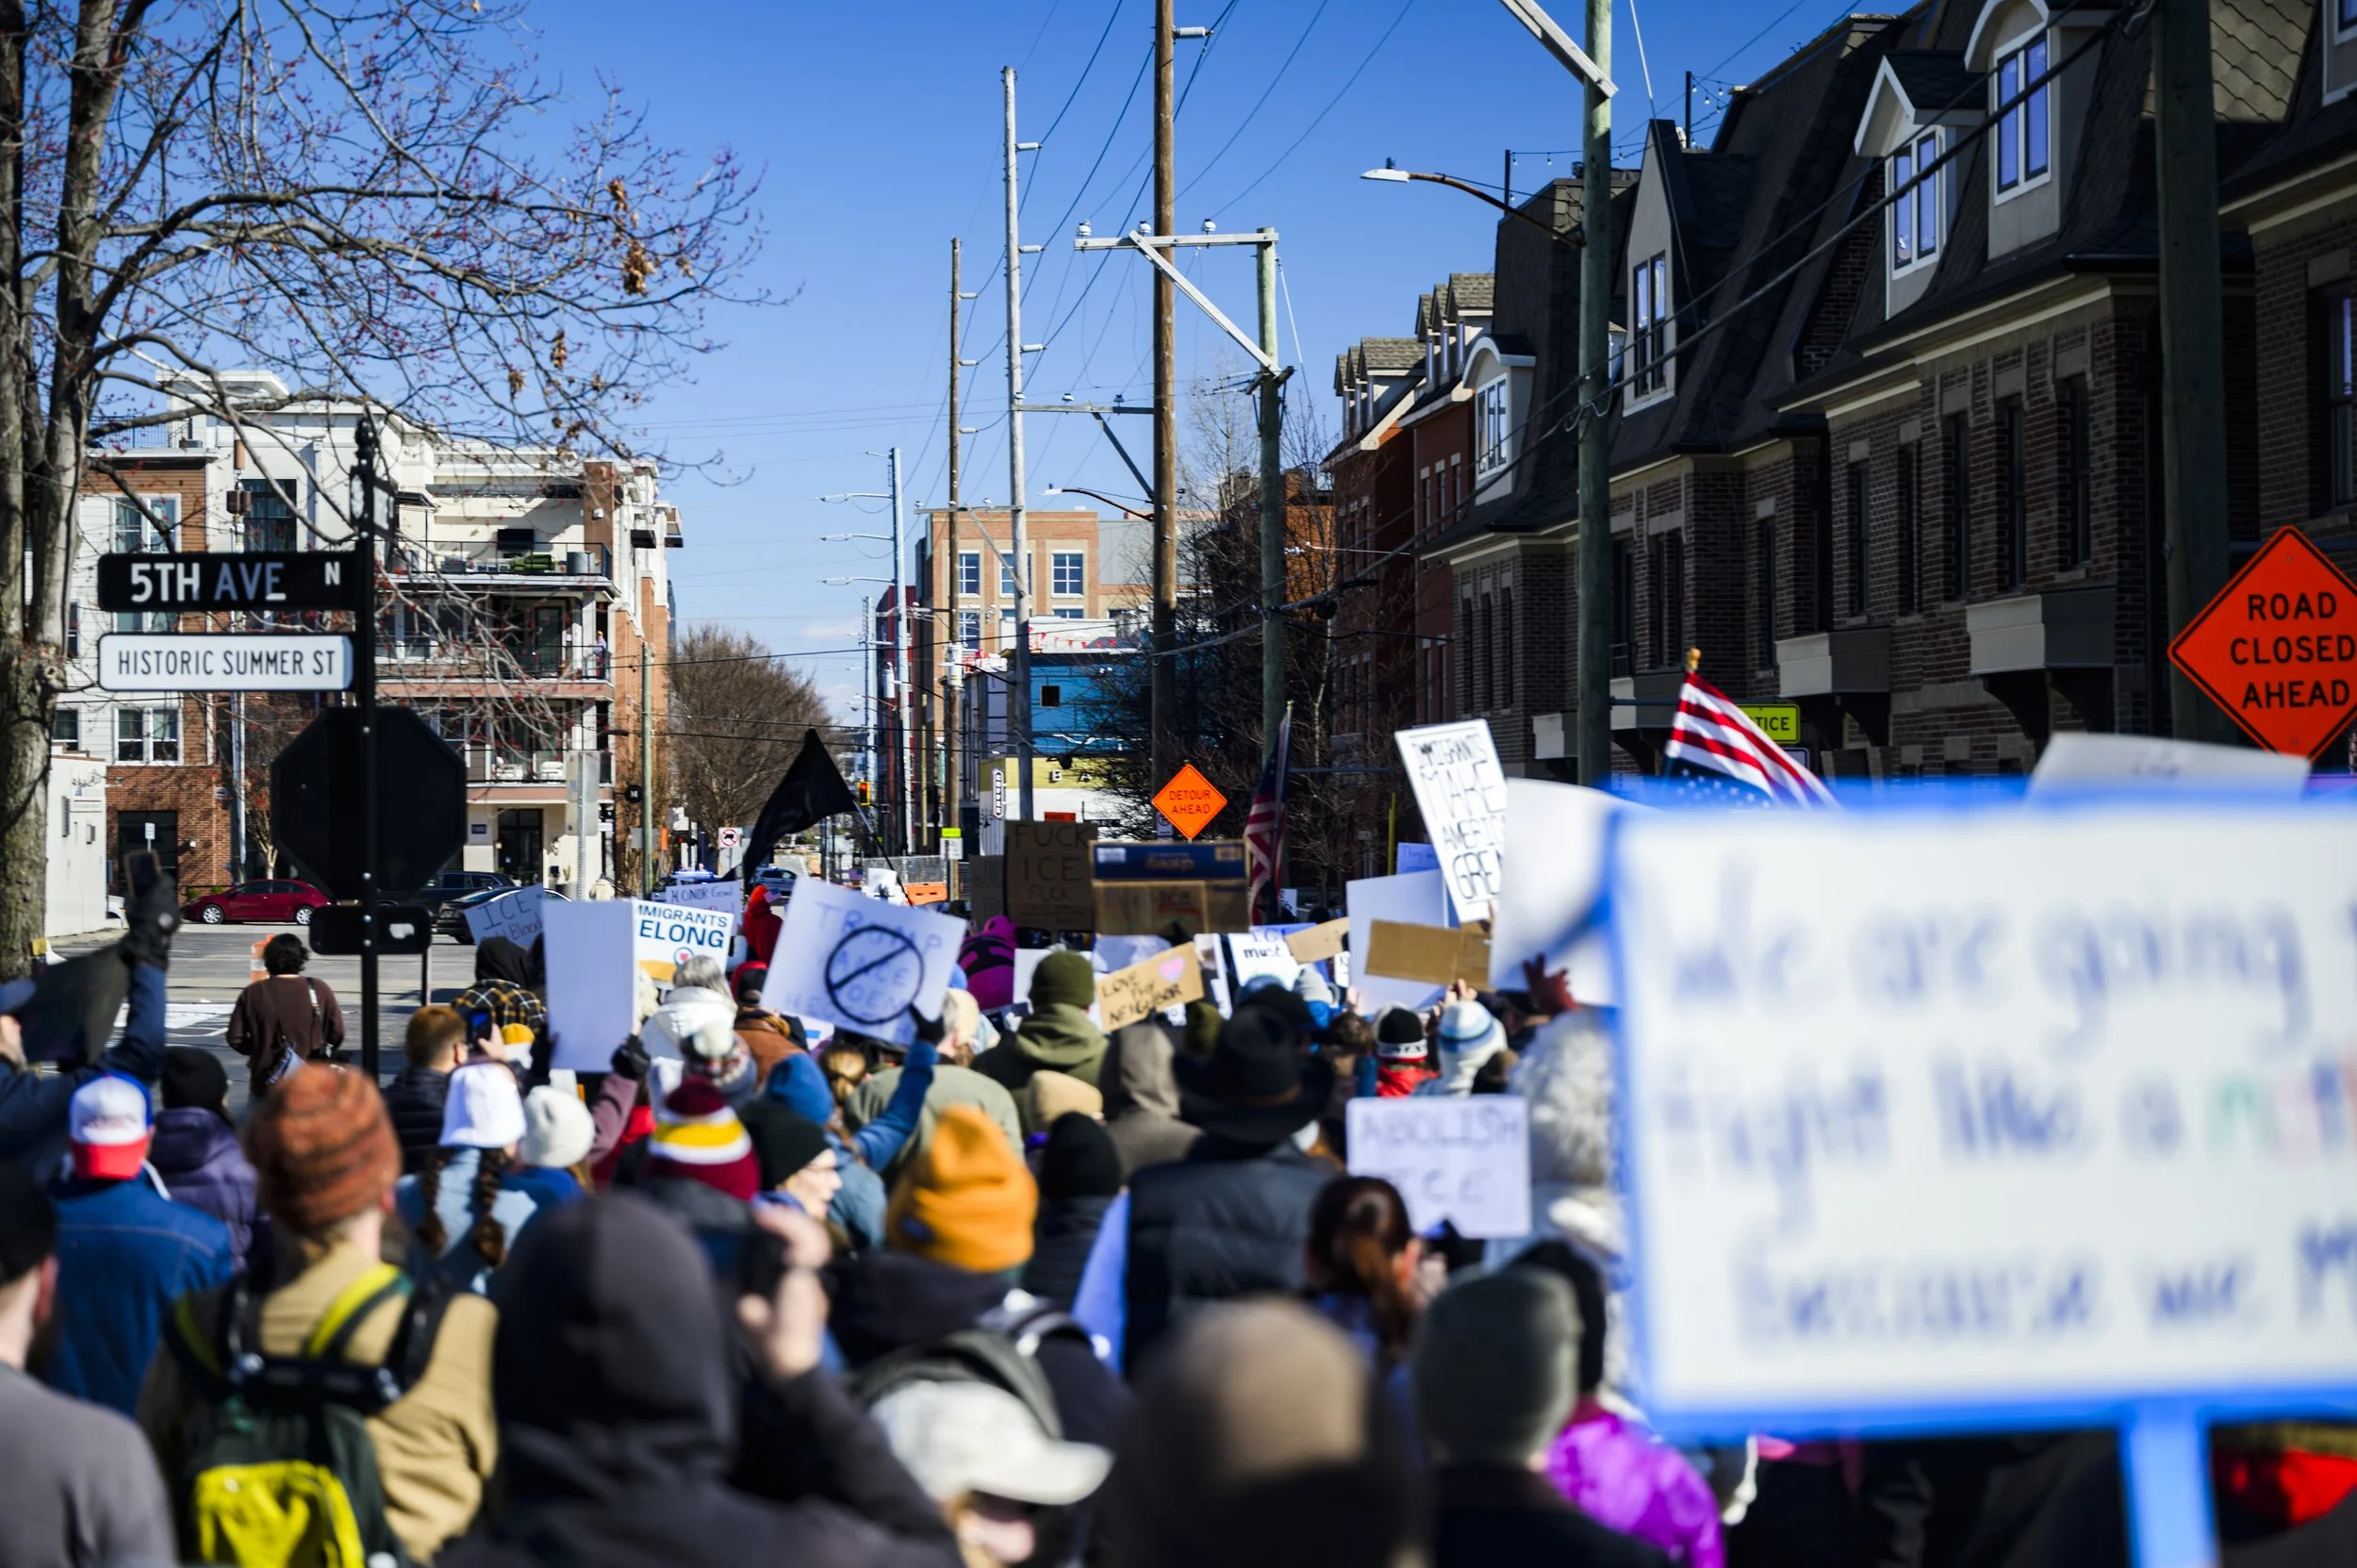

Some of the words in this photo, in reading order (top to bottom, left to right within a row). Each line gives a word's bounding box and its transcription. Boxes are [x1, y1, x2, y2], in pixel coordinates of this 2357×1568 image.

[130, 562, 200, 602] 5TH
[213, 562, 287, 602] AVE
[324, 561, 340, 586] N
[2248, 592, 2337, 621] ROAD
[118, 650, 214, 676] HISTORIC
[223, 650, 304, 676] SUMMER
[313, 650, 336, 676] ST
[2230, 635, 2356, 666] CLOSED
[2241, 680, 2350, 709] AHEAD
[1750, 717, 1790, 731] TICE
[1169, 789, 1211, 801] DETOUR
[1172, 803, 1211, 815] AHEAD
[1014, 823, 1091, 850] FUCK
[1024, 855, 1084, 882] ICE
[477, 892, 532, 931] ICE
[638, 904, 728, 928] MIGRANTS
[639, 919, 725, 949] ELONG
[1102, 970, 1139, 998] LOVE
[1360, 1104, 1520, 1150] ABOLISH
